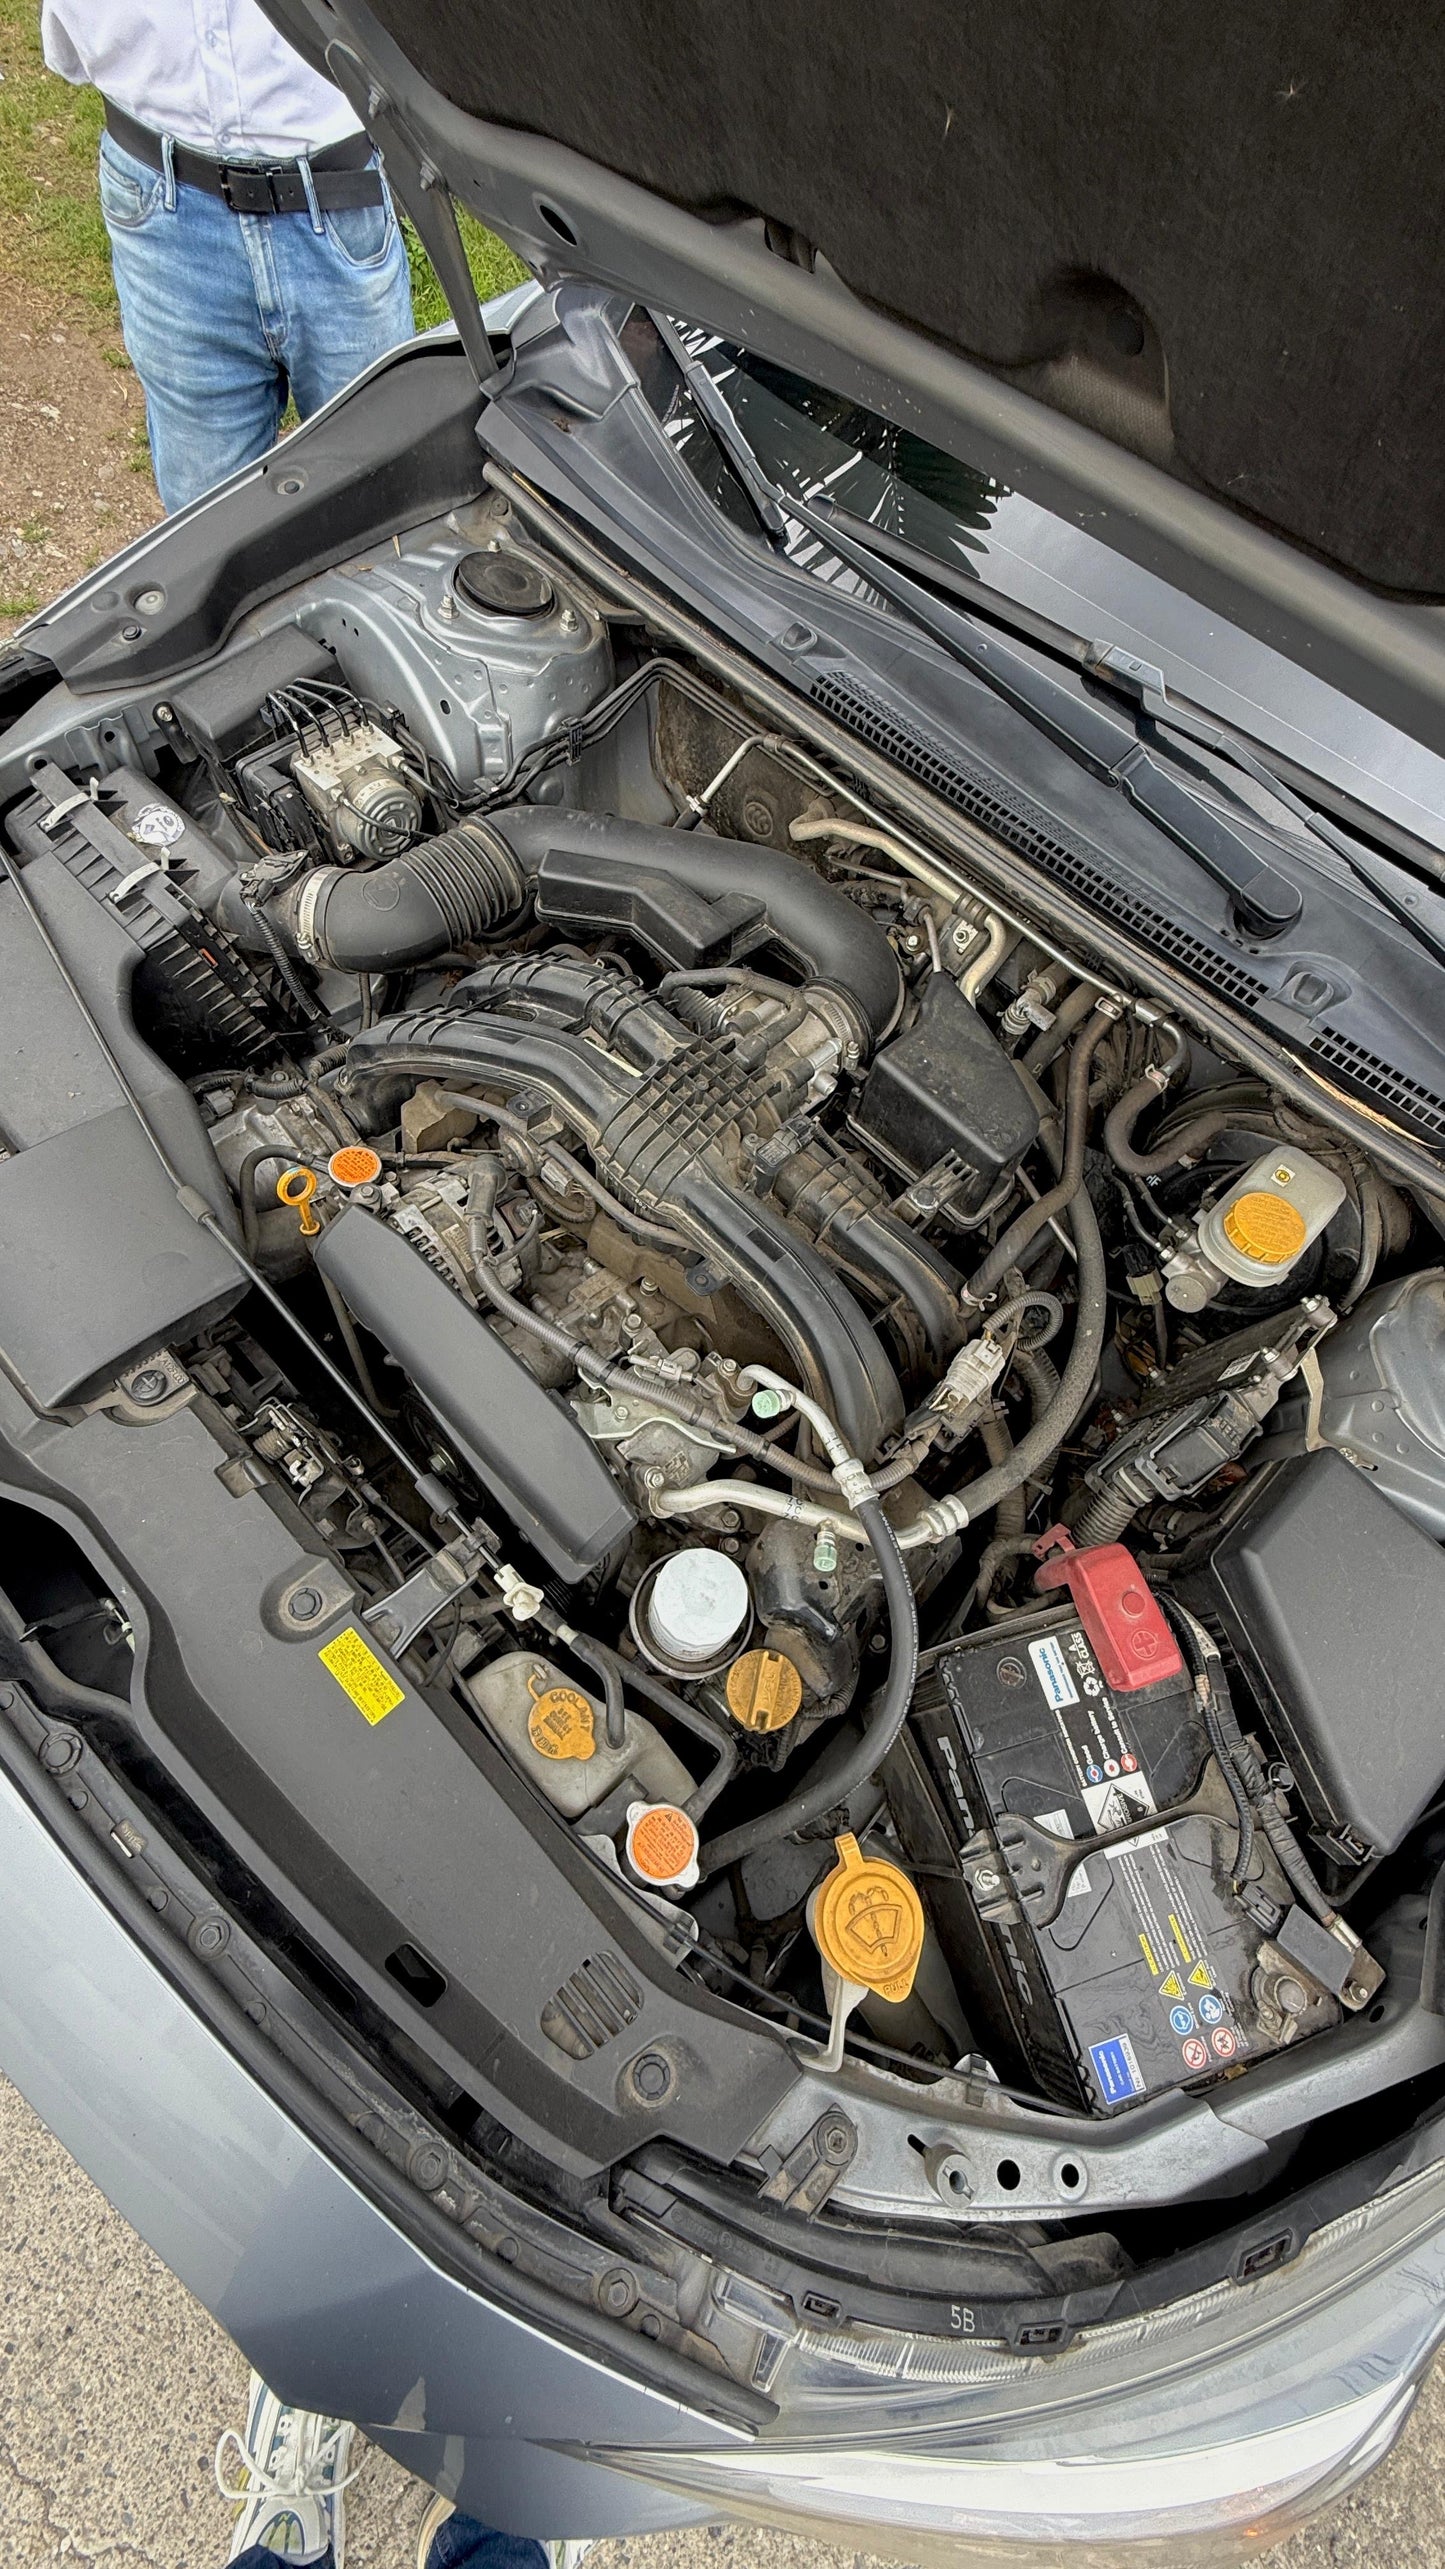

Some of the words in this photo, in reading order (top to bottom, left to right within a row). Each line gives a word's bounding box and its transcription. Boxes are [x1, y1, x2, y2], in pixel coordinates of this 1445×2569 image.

[1074, 1631, 1090, 1659] CLASS
[1039, 1647, 1064, 1703] Panasonic
[550, 1690, 590, 1733] COOLANT
[1111, 1720, 1119, 1729] to
[1081, 1745, 1094, 1765] Good
[1097, 1734, 1111, 1760] Charge
[1114, 1729, 1128, 1754] Consult
[937, 1736, 1034, 2006] Pannic
[883, 1978, 909, 1996] PULL
[1098, 2050, 1117, 2095] Panasonic
[951, 2304, 976, 2333] 5B
